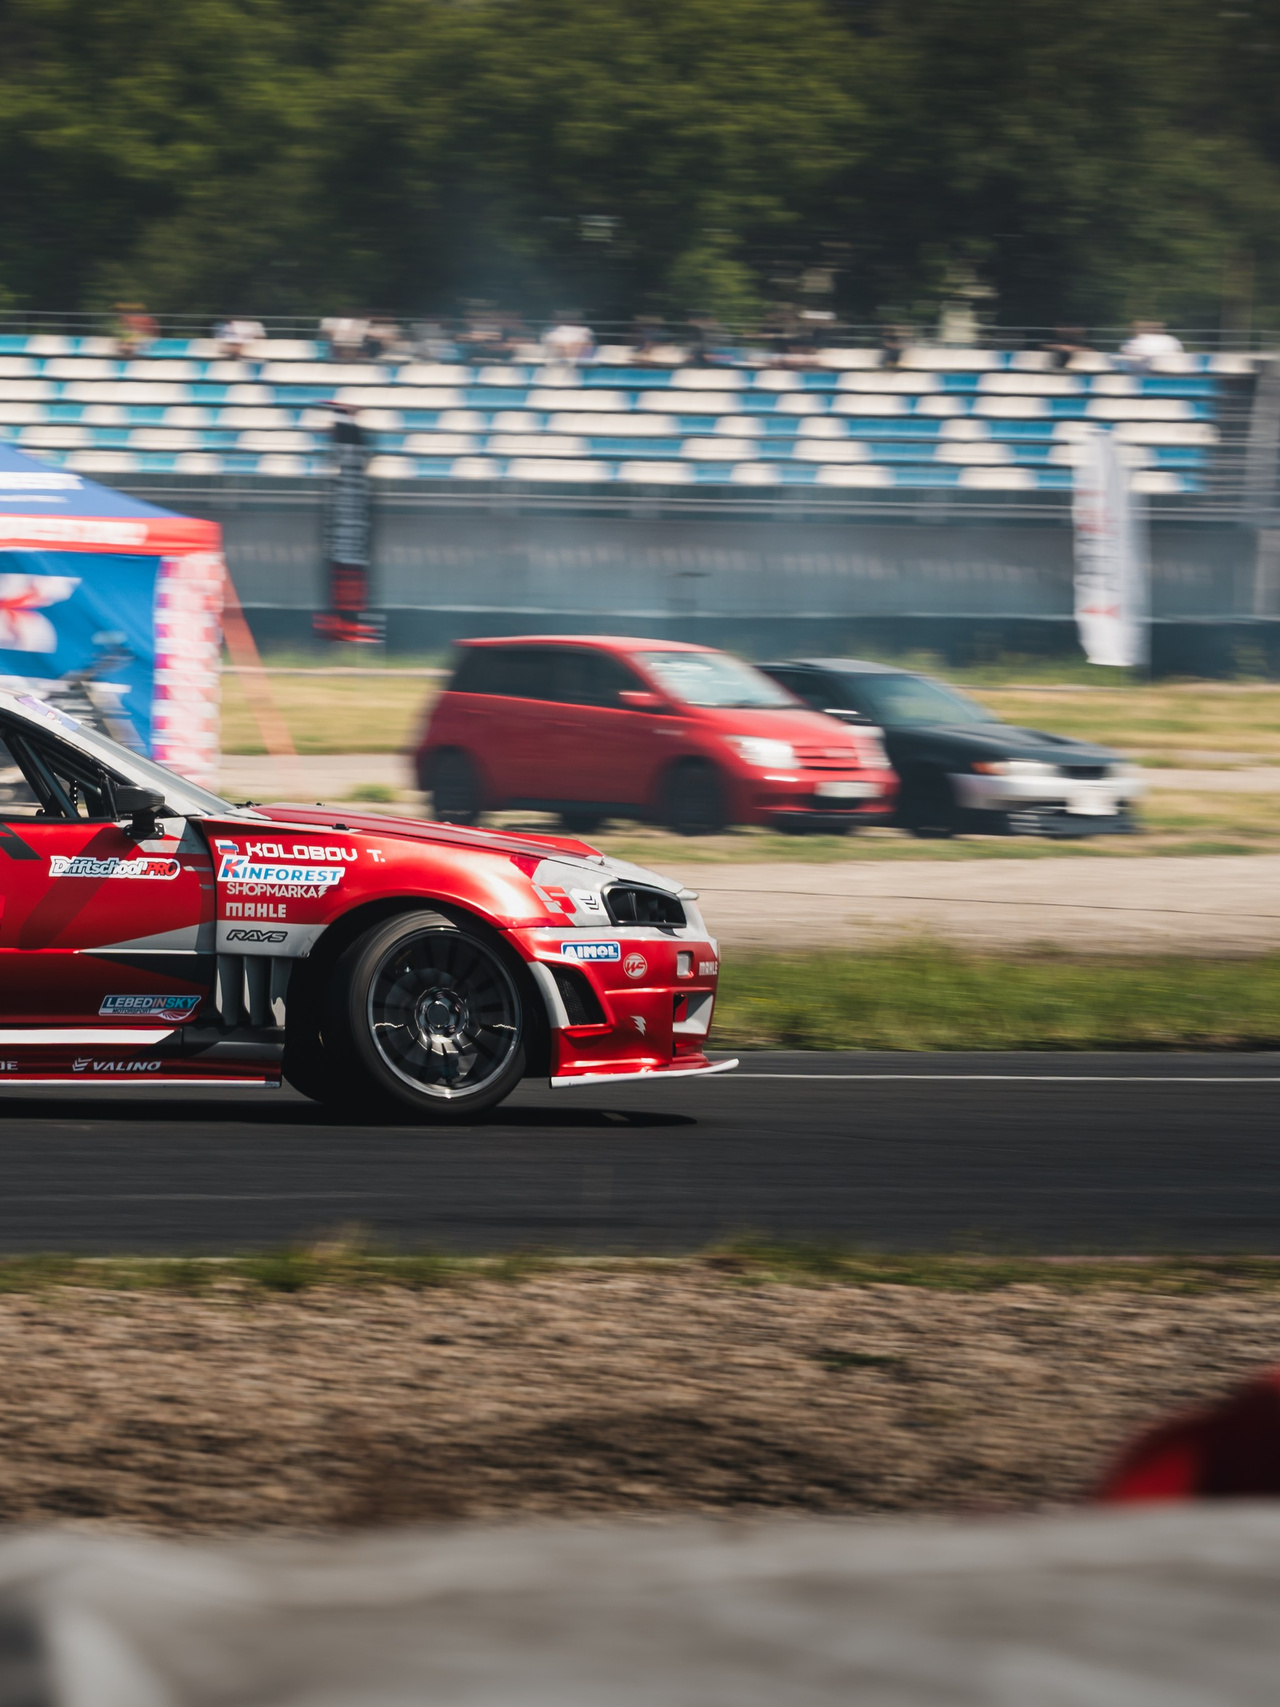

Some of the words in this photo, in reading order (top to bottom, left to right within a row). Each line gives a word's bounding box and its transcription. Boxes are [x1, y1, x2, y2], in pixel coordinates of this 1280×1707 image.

[245, 842, 358, 862] KOLOBOV
[366, 849, 386, 863] T.
[221, 859, 341, 882] KINFOREST
[226, 902, 286, 918] MAHLE
[226, 929, 288, 942] RAYS
[106, 997, 197, 1008] LEBEDINSKY
